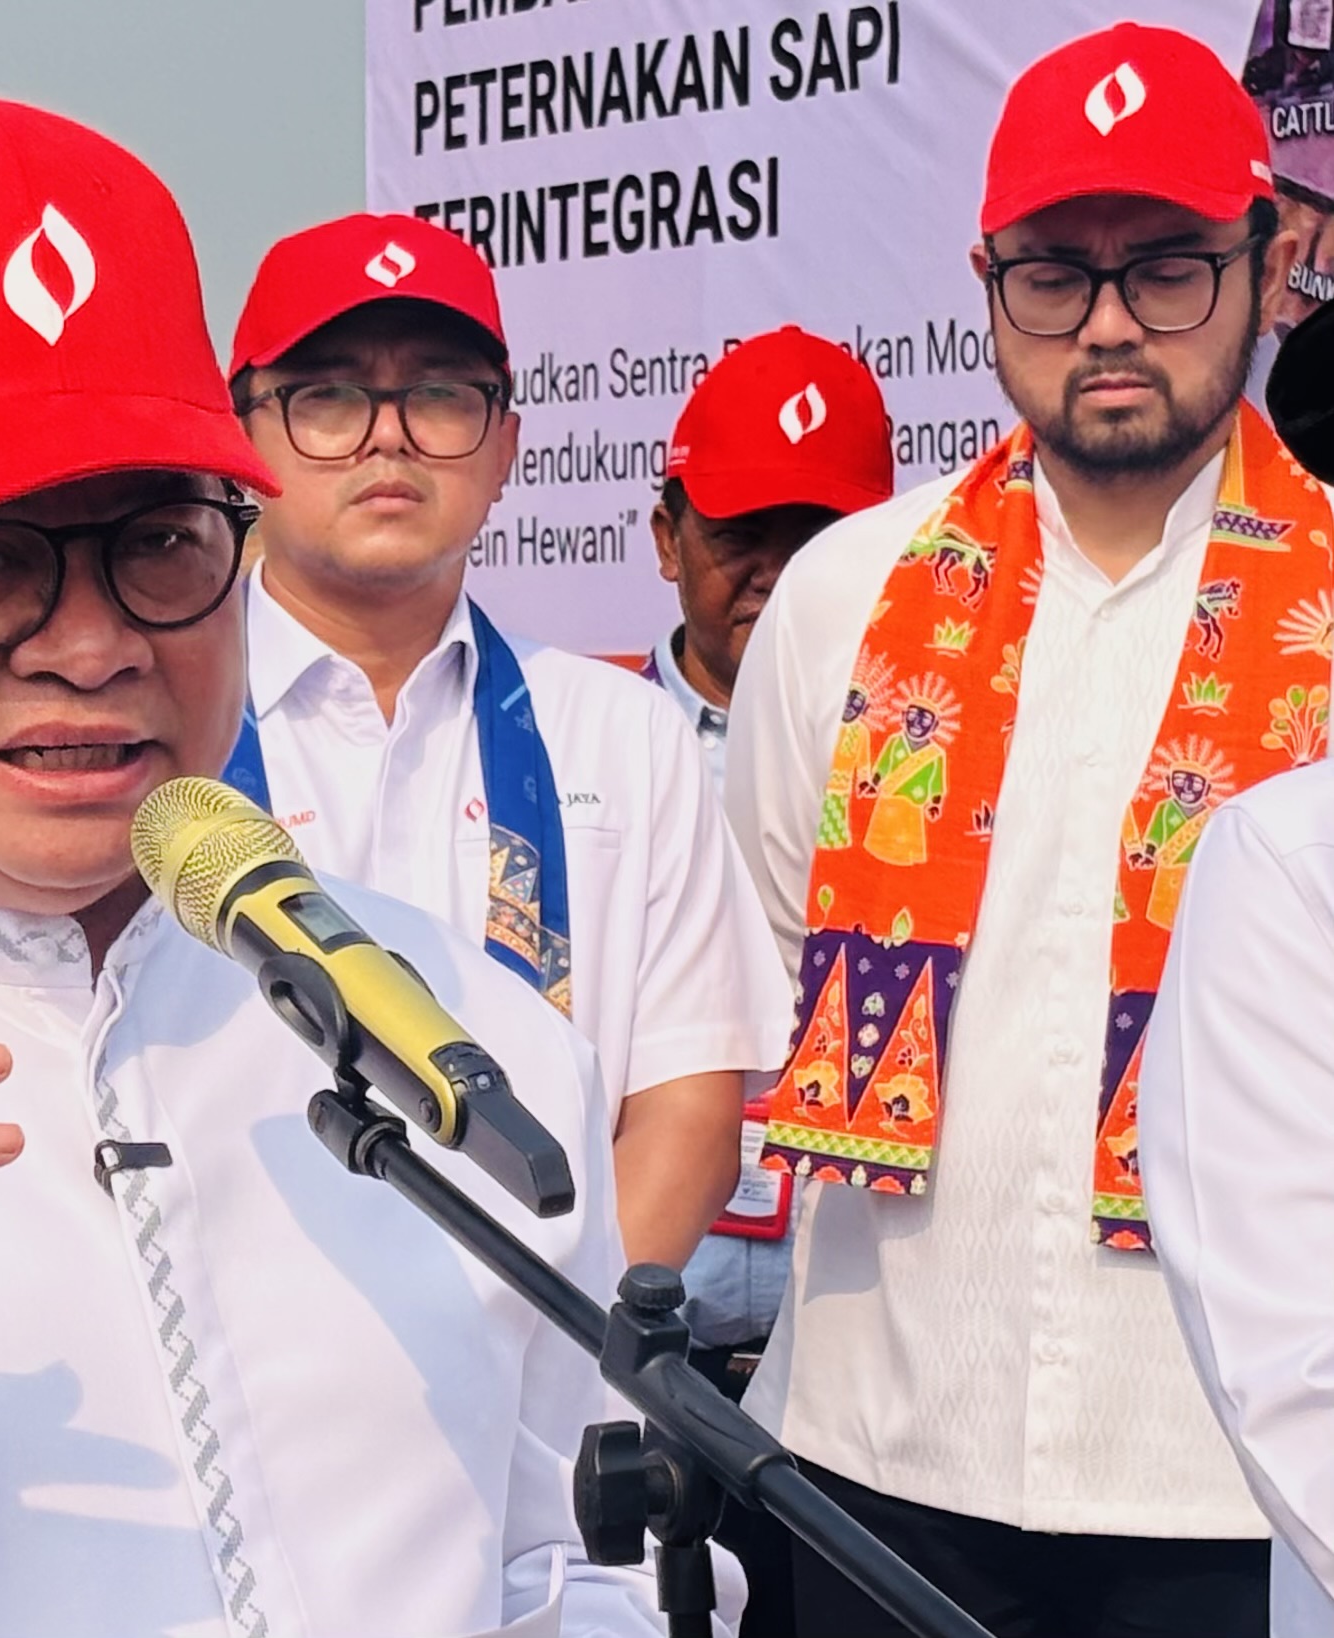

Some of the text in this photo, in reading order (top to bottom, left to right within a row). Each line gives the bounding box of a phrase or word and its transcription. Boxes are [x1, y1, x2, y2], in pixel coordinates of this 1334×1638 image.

[414, 1, 901, 156] PETERNAKAN SAPI
[513, 353, 600, 405] udkan
[609, 347, 710, 398] Sentra
[566, 792, 602, 808] JAYA
[274, 810, 317, 829] UMD
